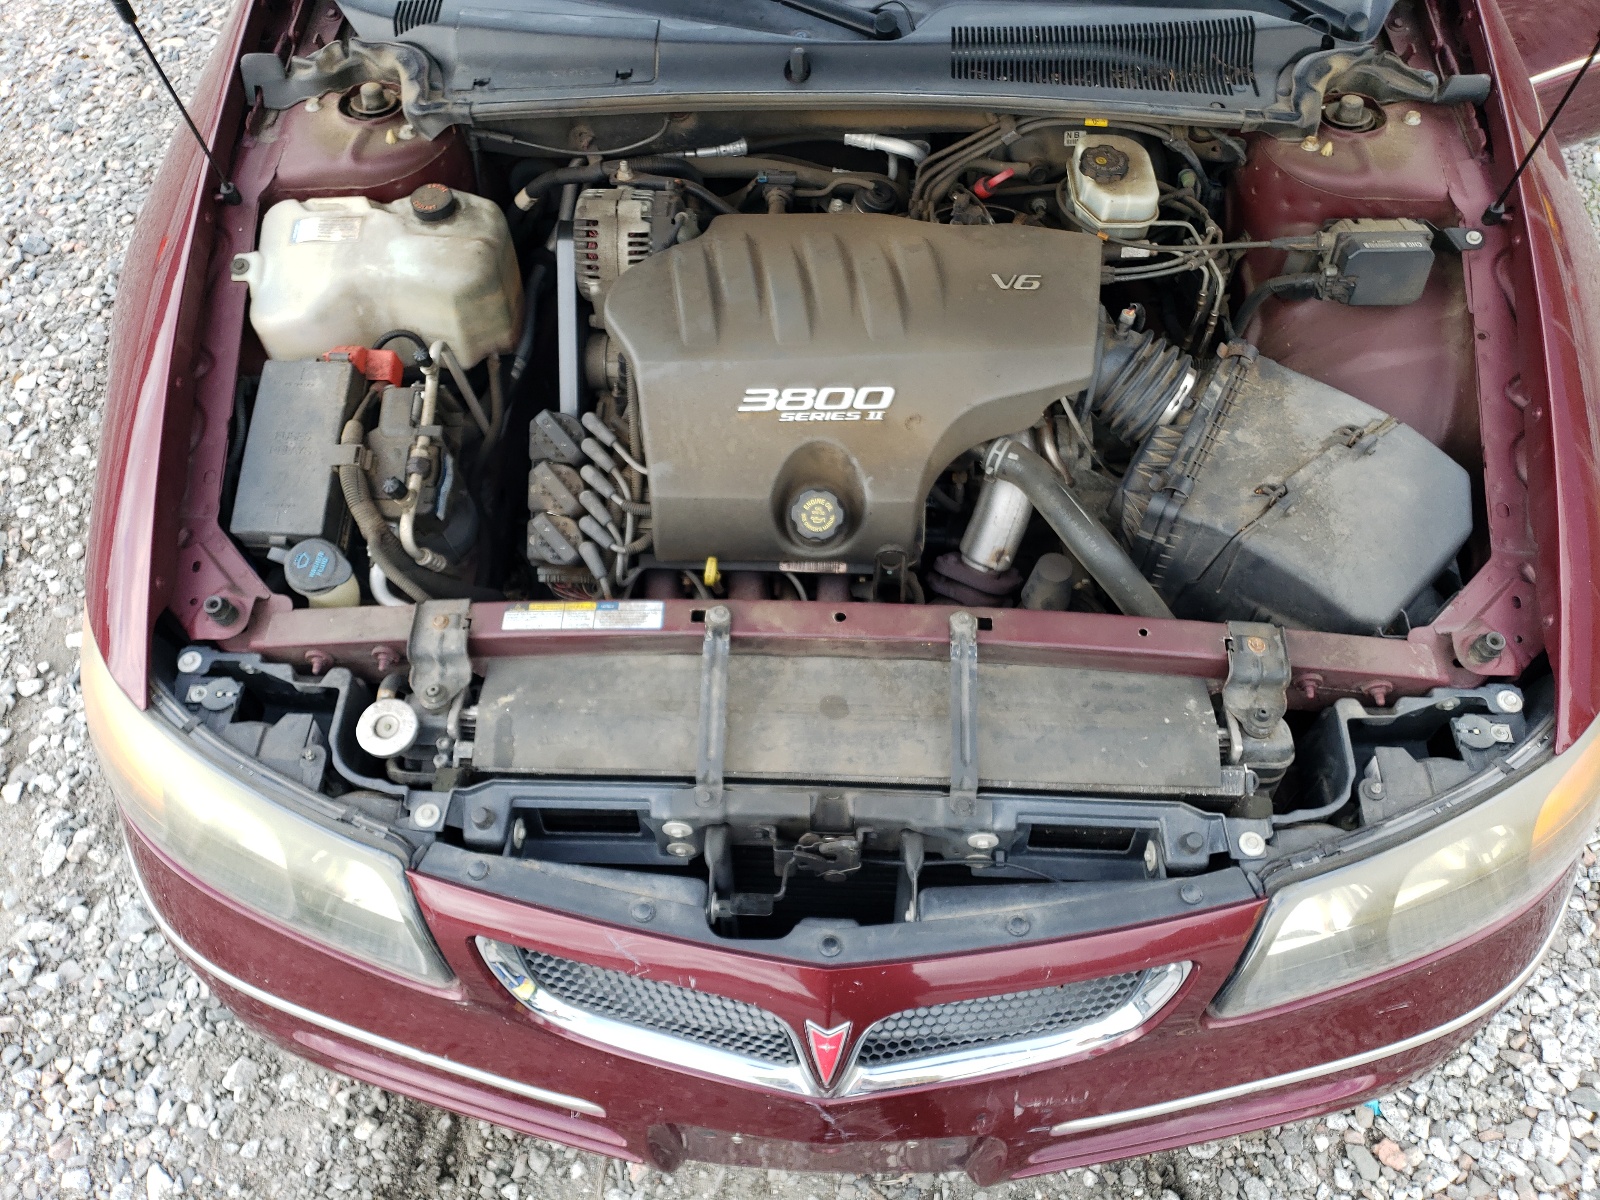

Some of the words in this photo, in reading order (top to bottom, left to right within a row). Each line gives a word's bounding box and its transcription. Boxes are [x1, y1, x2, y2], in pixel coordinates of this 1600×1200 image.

[991, 273, 1042, 290] V6
[737, 386, 896, 412] 3800
[778, 410, 862, 422] SERIES
[864, 410, 887, 421] II
